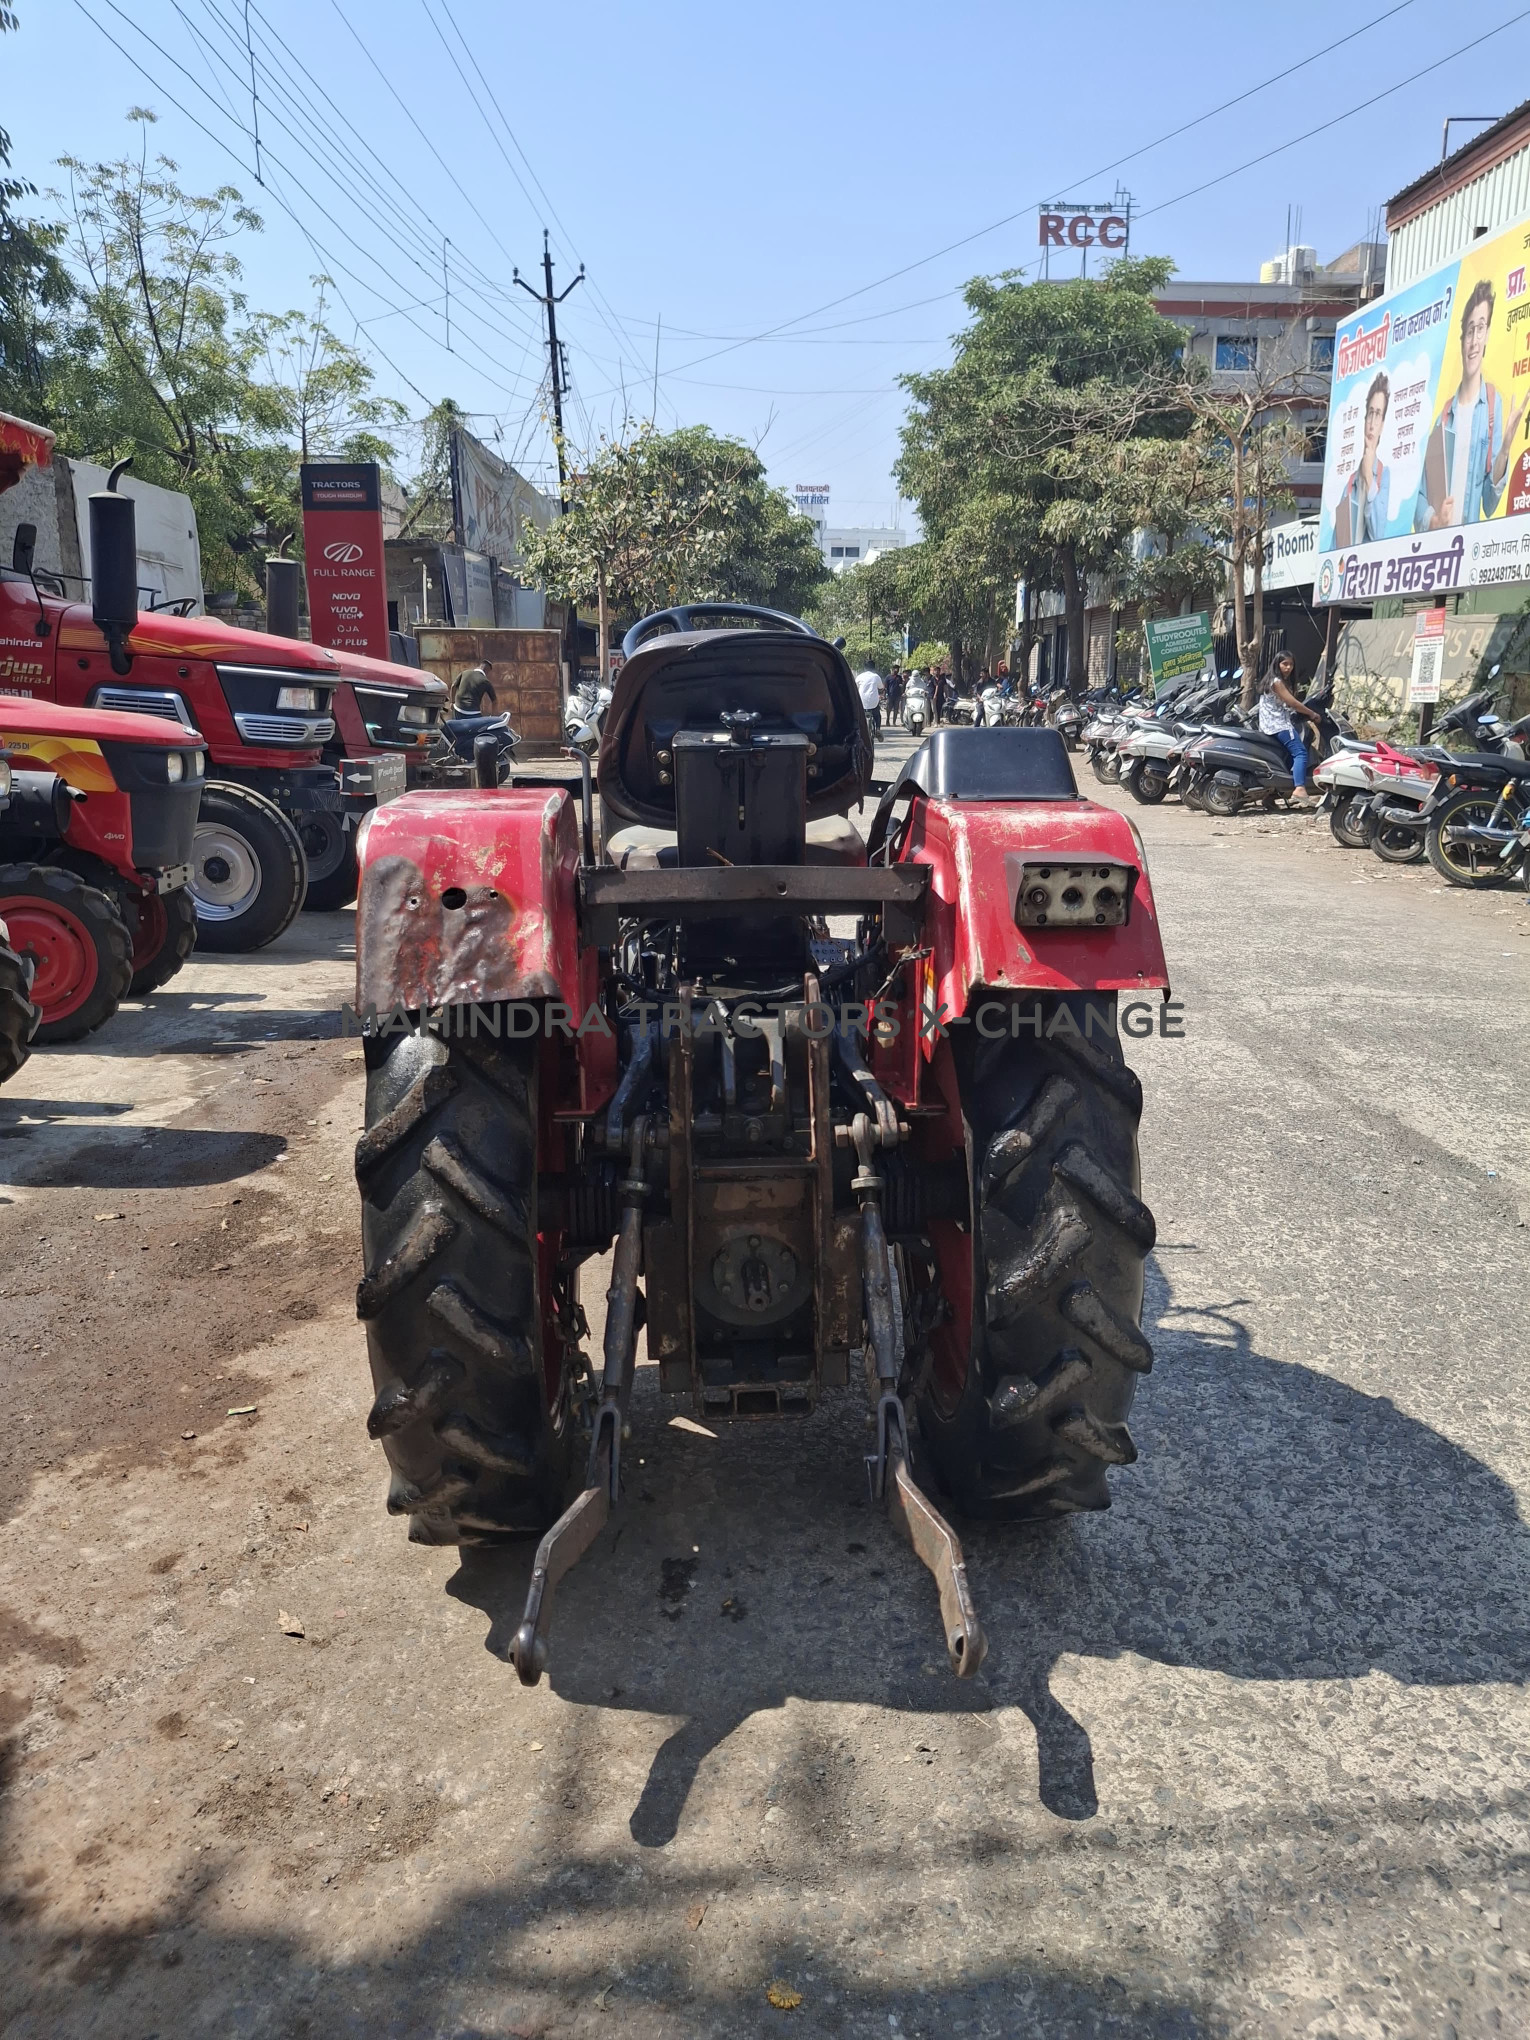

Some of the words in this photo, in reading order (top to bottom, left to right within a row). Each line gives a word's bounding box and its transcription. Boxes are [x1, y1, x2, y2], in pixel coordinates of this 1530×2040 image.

[1039, 214, 1126, 248] RCC
[1392, 314, 1408, 345] चिंता
[1433, 301, 1444, 325] का
[1444, 286, 1453, 320] ?
[311, 481, 361, 489] TRACTORS
[1277, 531, 1314, 559] Rooms
[1341, 554, 1383, 600] दिशा
[1384, 535, 1464, 592] अकॅडमी
[313, 569, 338, 577] FULL
[341, 569, 376, 577] RANGE
[337, 625, 360, 633] OJA
[1151, 627, 1208, 644] STUDYROOUTES
[1165, 637, 1197, 648] ADMISSION
[1160, 642, 1202, 655] CONSULTANCY
[12, 675, 52, 685] ultra-1
[21, 689, 33, 699] DI
[8, 741, 21, 749] 225
[22, 742, 30, 750] DI
[103, 832, 125, 840] 4WD
